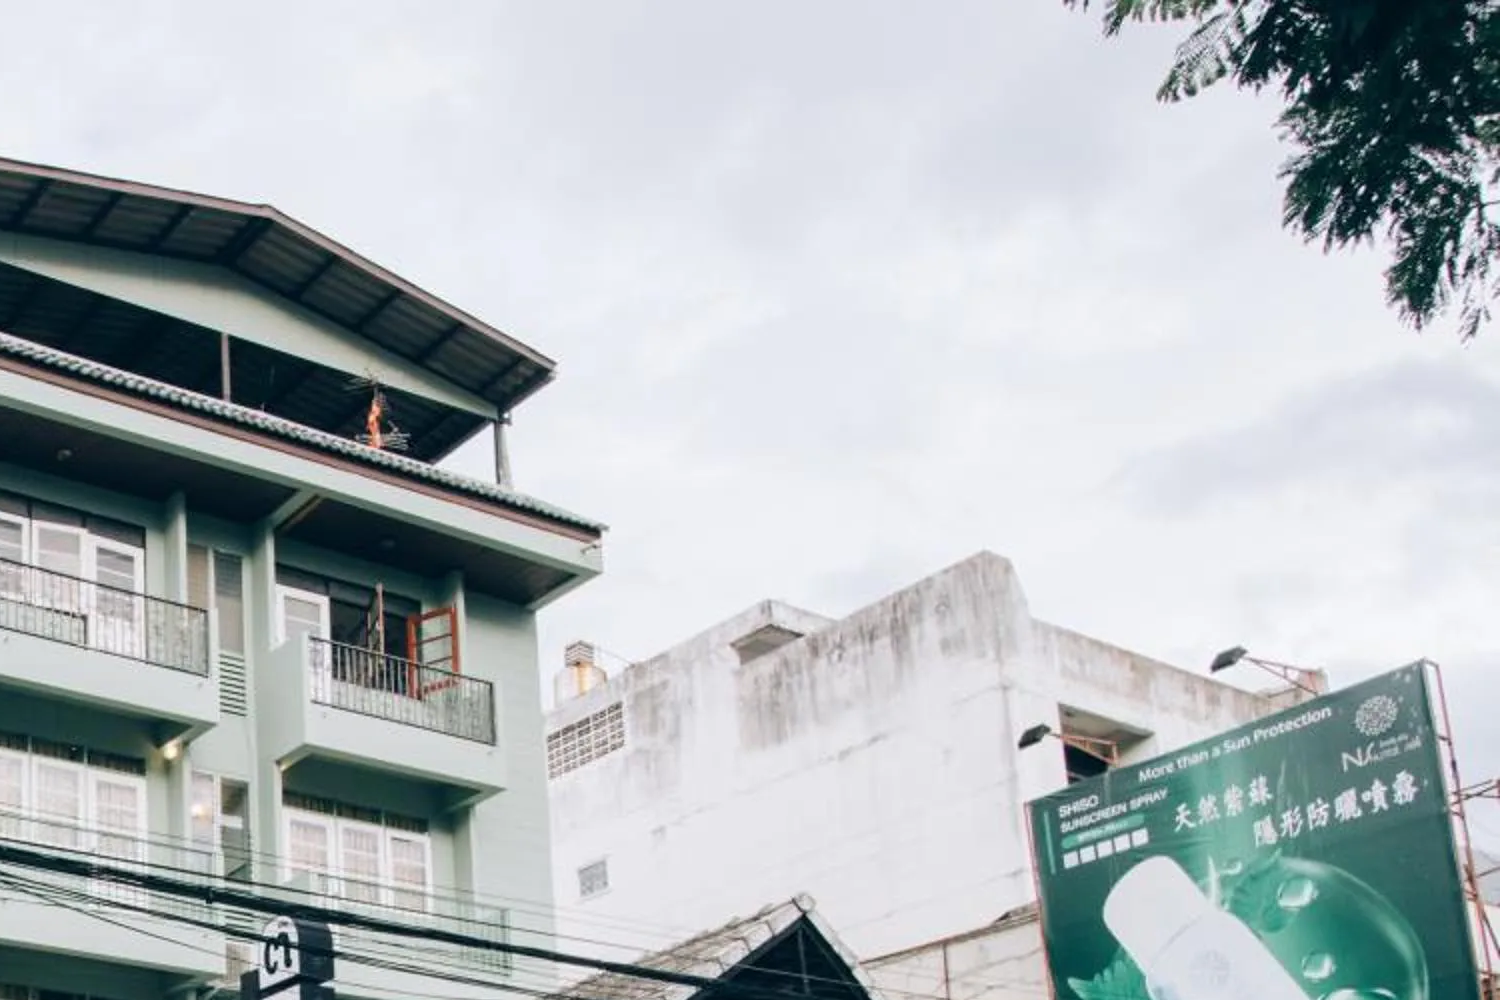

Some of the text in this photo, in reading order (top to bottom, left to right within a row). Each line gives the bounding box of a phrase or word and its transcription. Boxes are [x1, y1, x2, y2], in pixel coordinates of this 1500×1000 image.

[1138, 706, 1332, 783] More than a Sun Protection
[1060, 803, 1127, 833] SUNSCREEN
[1129, 787, 1168, 810] SPRAY
